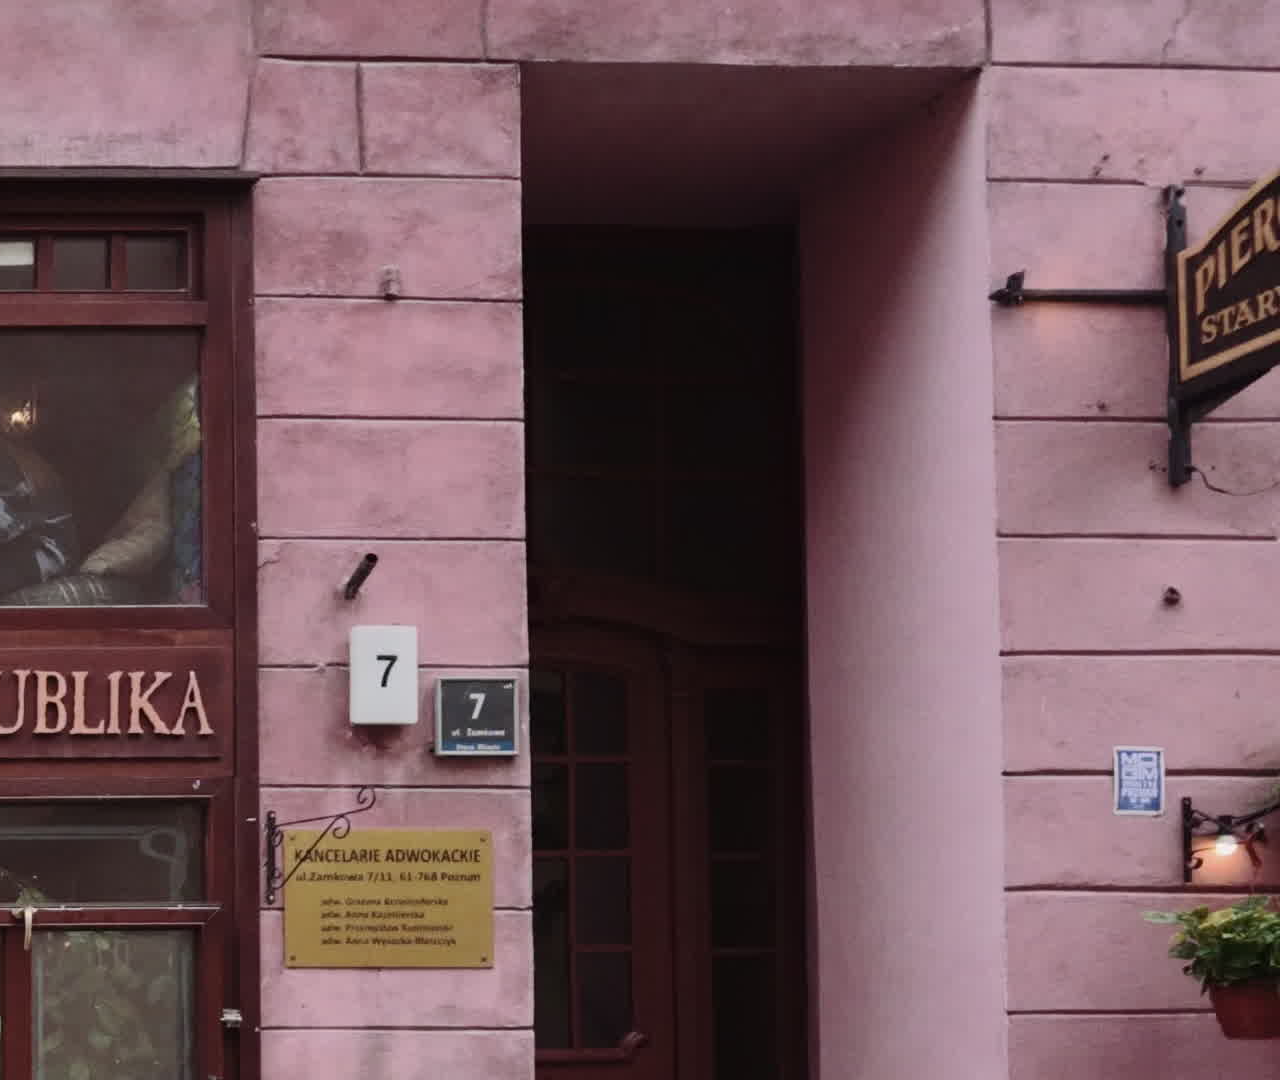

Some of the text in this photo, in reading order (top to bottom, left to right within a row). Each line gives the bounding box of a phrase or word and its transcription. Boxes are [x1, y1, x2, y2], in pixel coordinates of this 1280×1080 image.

[1194, 196, 1280, 316] PIER
[1200, 286, 1280, 345] STAR
[376, 655, 398, 688] 7
[469, 693, 486, 720] 7
[294, 849, 481, 863] KANCELARIE ADWOKACKIE
